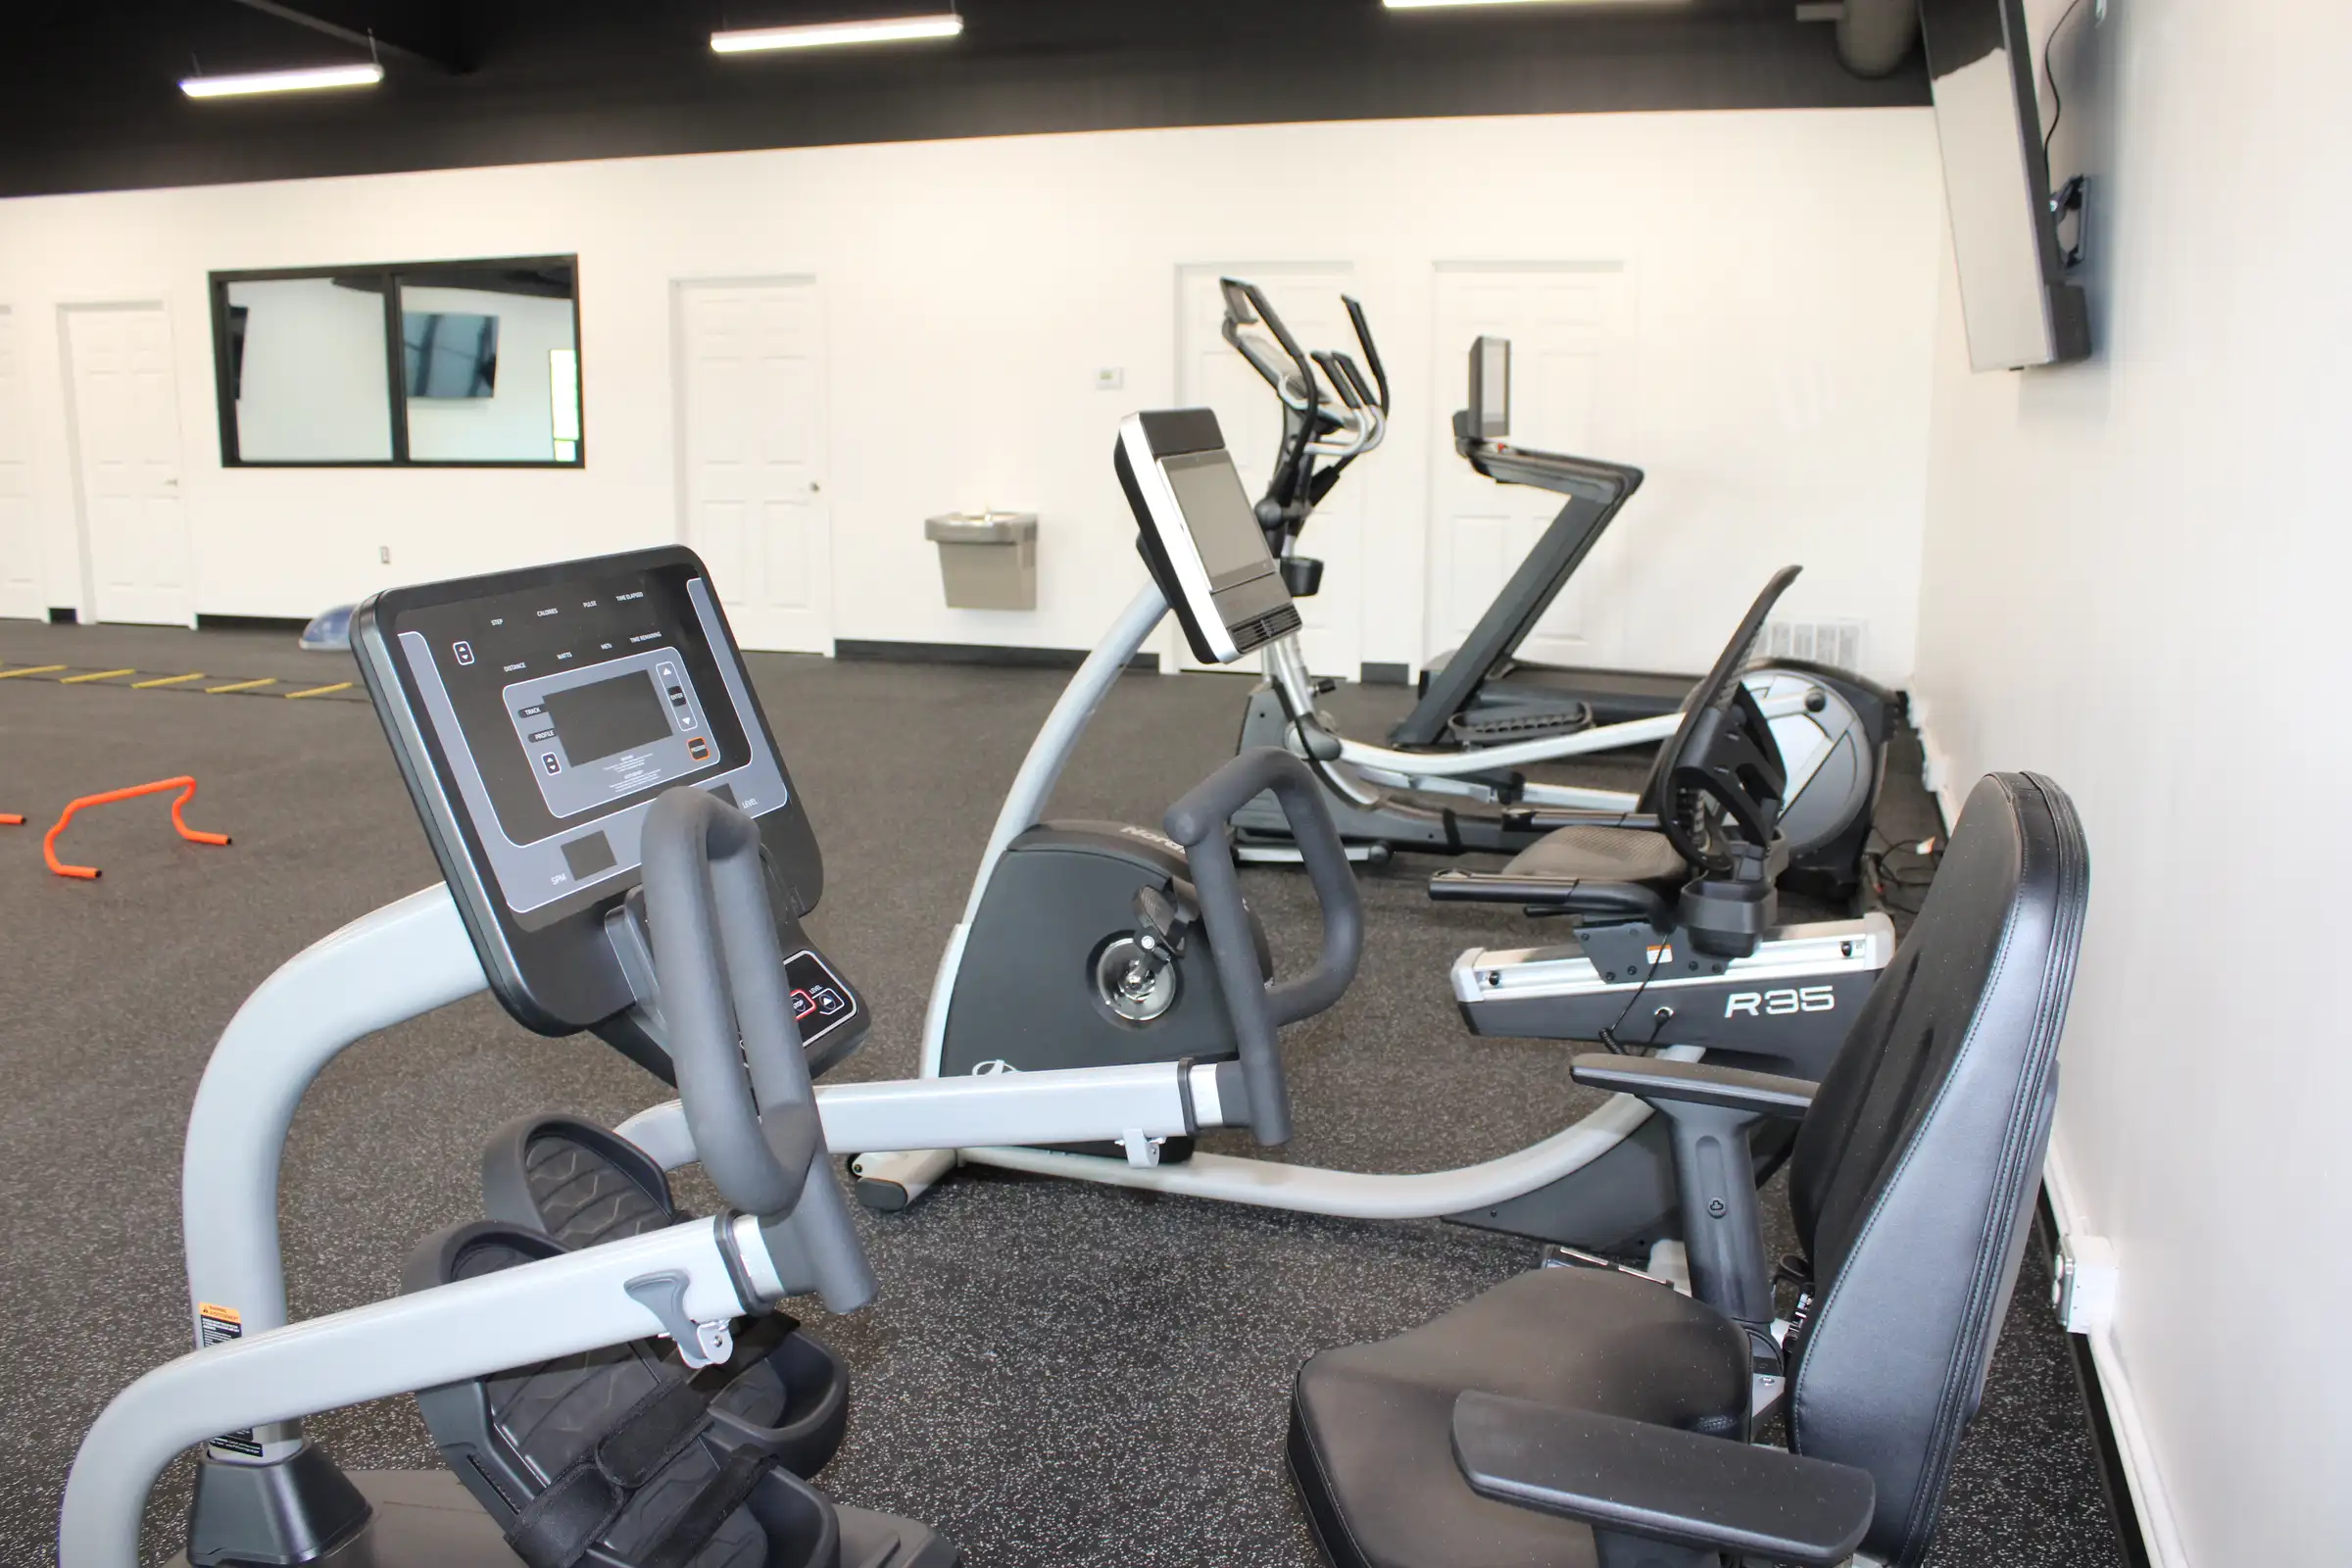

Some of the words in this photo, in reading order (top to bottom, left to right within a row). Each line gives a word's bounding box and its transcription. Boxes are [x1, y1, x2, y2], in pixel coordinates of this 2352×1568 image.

[537, 608, 558, 616] CALORIES
[557, 651, 572, 660] WATTS
[504, 662, 526, 671] DISTANCE
[669, 692, 684, 701] ENTER
[524, 707, 541, 715] TRACK
[534, 729, 555, 740] PROFILE
[742, 798, 758, 809] LEVEL
[551, 872, 566, 886] SPM
[809, 984, 823, 995] LEVEL
[1725, 985, 1835, 1018] R35
